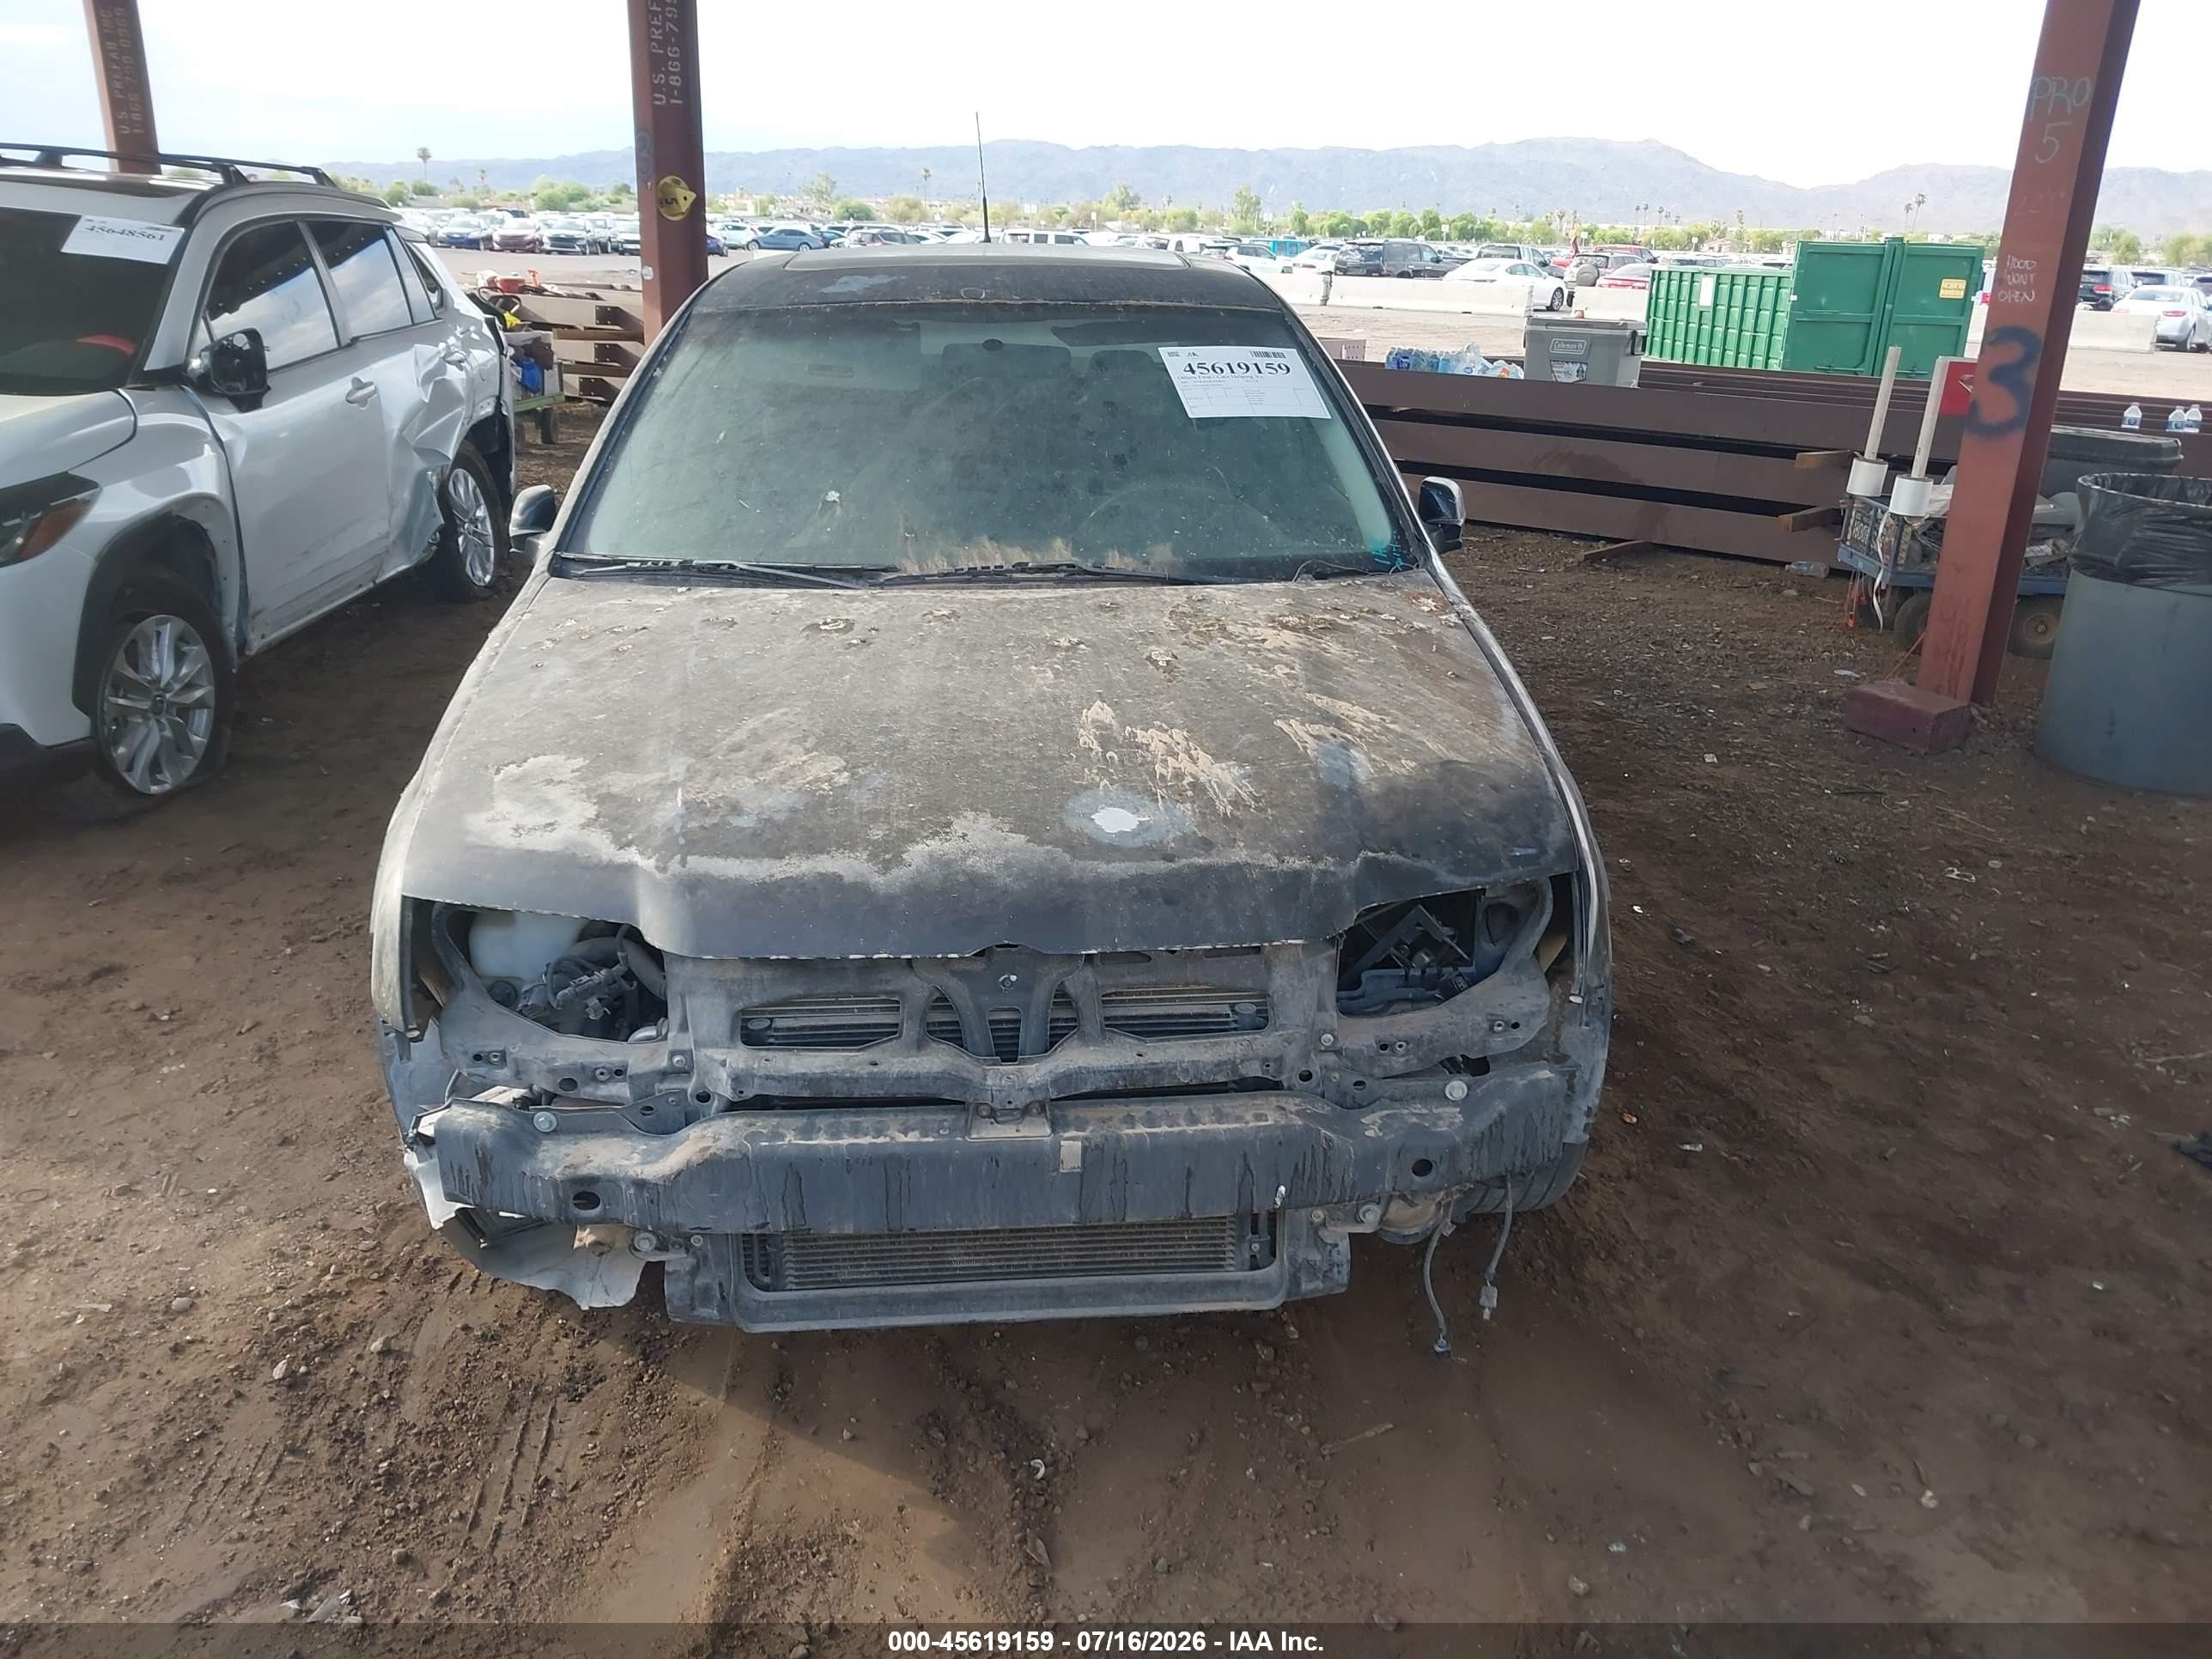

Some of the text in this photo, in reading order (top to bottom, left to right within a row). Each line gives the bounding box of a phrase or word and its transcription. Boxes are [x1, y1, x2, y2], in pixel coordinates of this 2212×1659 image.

[653, 66, 666, 106] U.S.
[2035, 121, 2072, 164] 5
[2006, 254, 2038, 270] HOOD
[1998, 289, 2035, 303] OPEN
[1182, 362, 1291, 375] 45619159
[1965, 325, 2044, 441] 3
